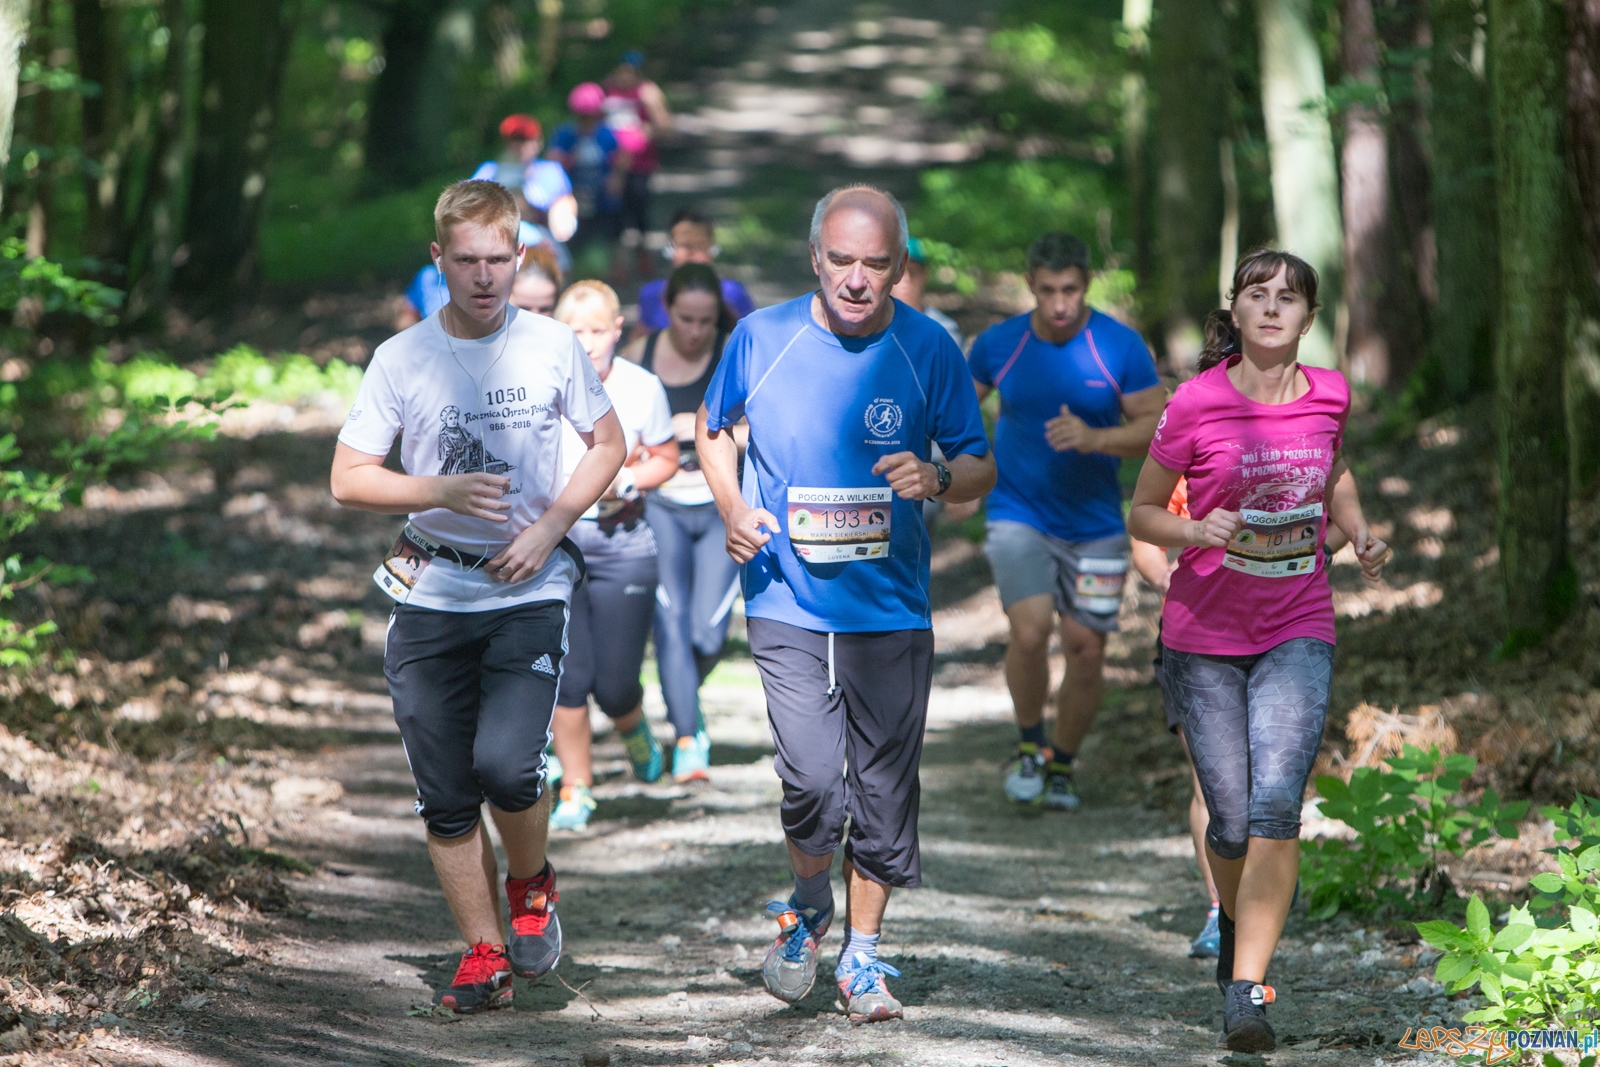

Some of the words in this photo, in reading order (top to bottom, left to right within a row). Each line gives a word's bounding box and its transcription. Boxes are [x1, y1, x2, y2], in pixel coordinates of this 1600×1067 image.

[485, 386, 527, 406] 1050
[501, 406, 530, 419] Chrztu
[833, 494, 845, 502] ZA
[846, 494, 885, 502] WILKIEM
[821, 509, 860, 529] 193
[1278, 516, 1288, 524] ZA
[1289, 508, 1315, 521] WILKIEM
[1265, 528, 1292, 548] 161
[531, 662, 556, 676] adidas
